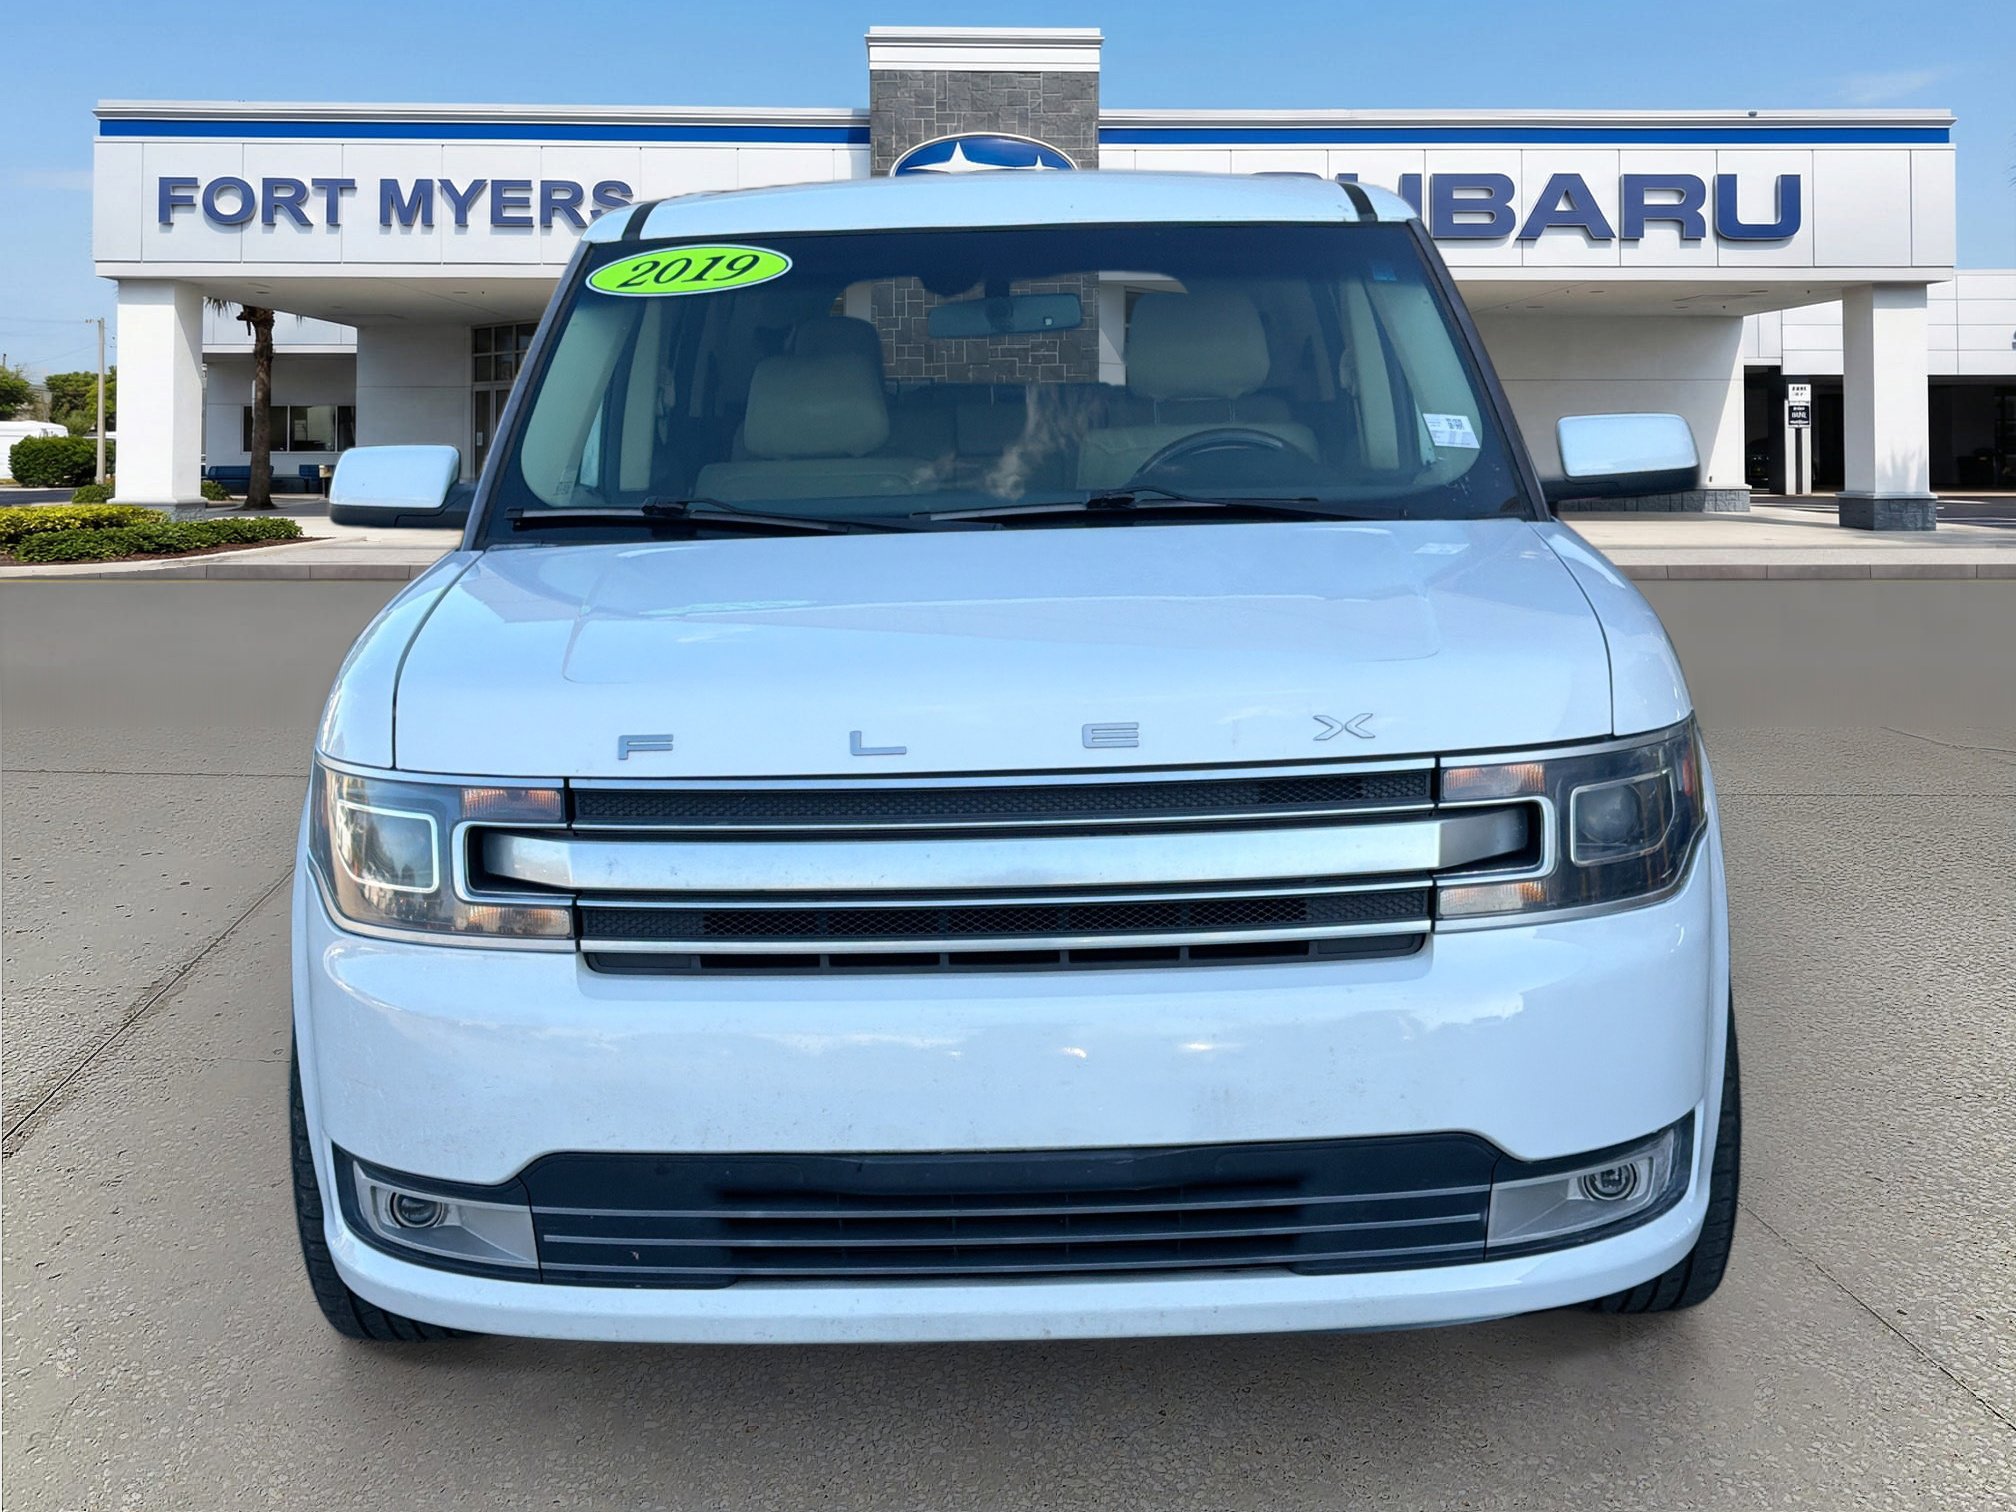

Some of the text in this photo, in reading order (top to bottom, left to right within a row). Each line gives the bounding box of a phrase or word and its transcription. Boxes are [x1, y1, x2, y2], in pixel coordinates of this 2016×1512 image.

[158, 176, 633, 228] FORT MYERS
[1253, 171, 1802, 240] BARU
[616, 254, 760, 288] 2019
[617, 711, 1376, 761] FLEX
